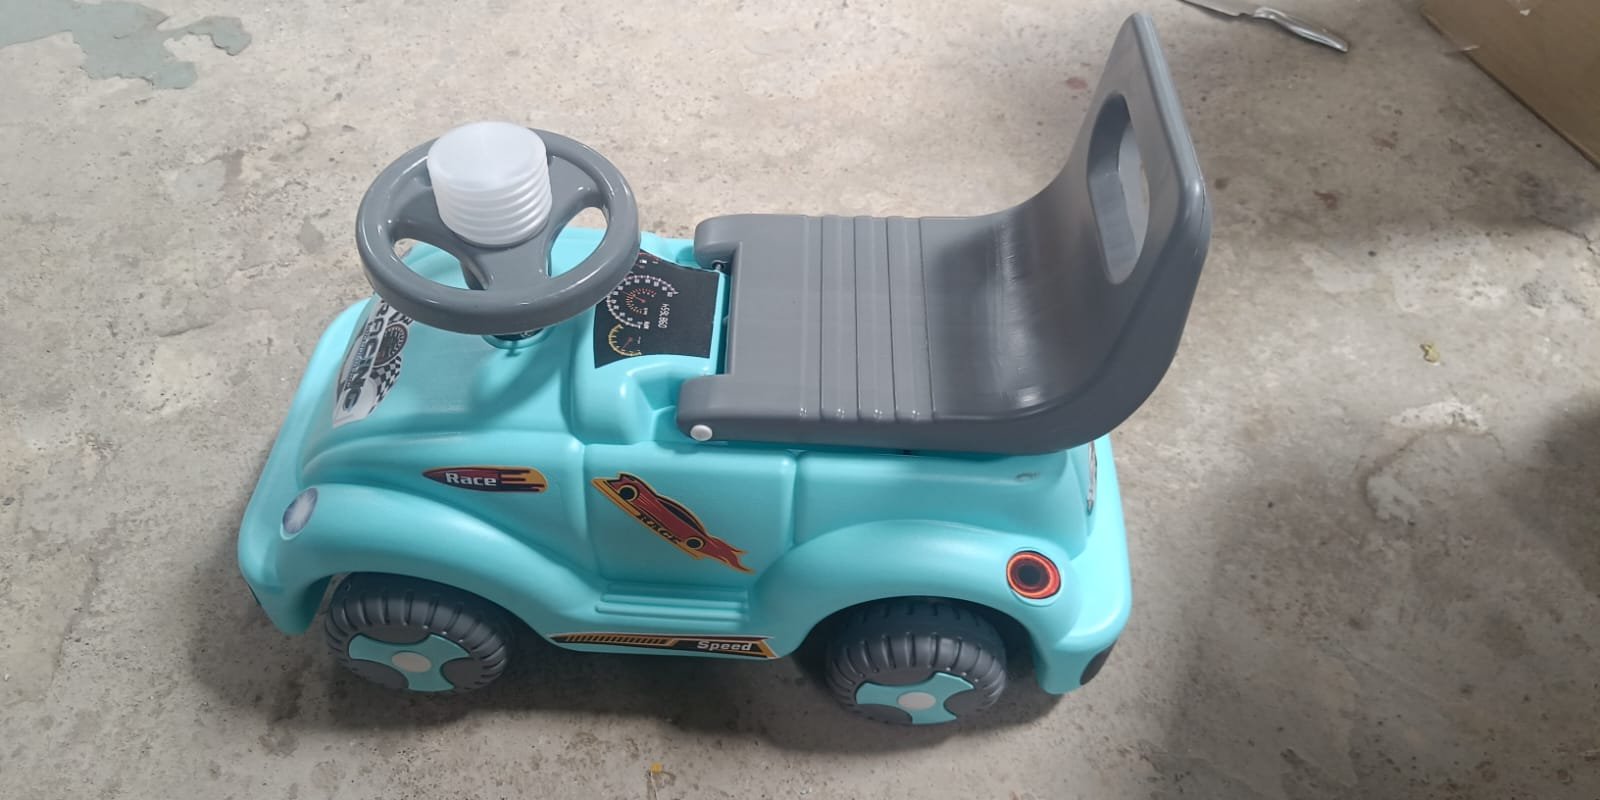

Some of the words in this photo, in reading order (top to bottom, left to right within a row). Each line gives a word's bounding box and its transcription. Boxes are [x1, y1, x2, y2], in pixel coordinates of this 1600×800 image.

[445, 472, 497, 486] Race
[637, 510, 682, 545] RACE
[697, 640, 752, 651] Speed
